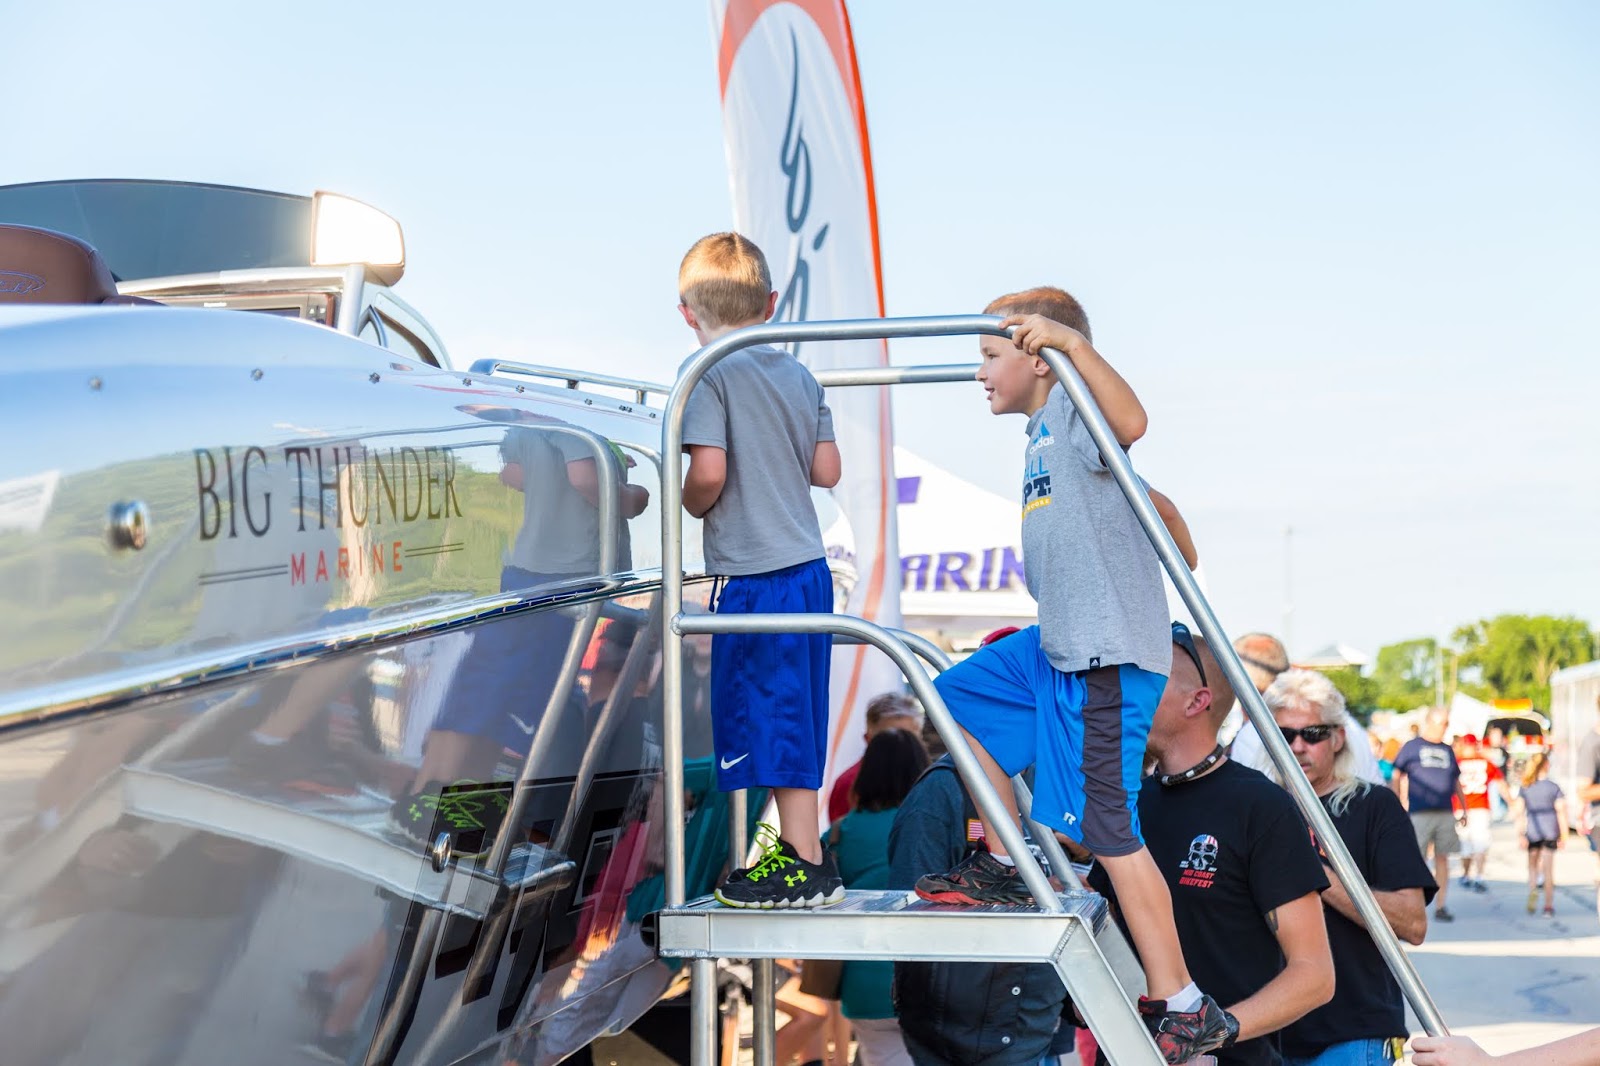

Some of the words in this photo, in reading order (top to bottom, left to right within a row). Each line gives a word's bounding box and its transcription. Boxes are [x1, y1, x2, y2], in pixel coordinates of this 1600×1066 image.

[1029, 436, 1055, 455] adas
[1025, 456, 1049, 480] LL
[194, 445, 271, 540] BIG
[284, 445, 463, 532] THUNDER
[291, 540, 403, 586] MARINE
[1179, 876, 1214, 889] BIKEFEST
[1193, 870, 1215, 879] COAST
